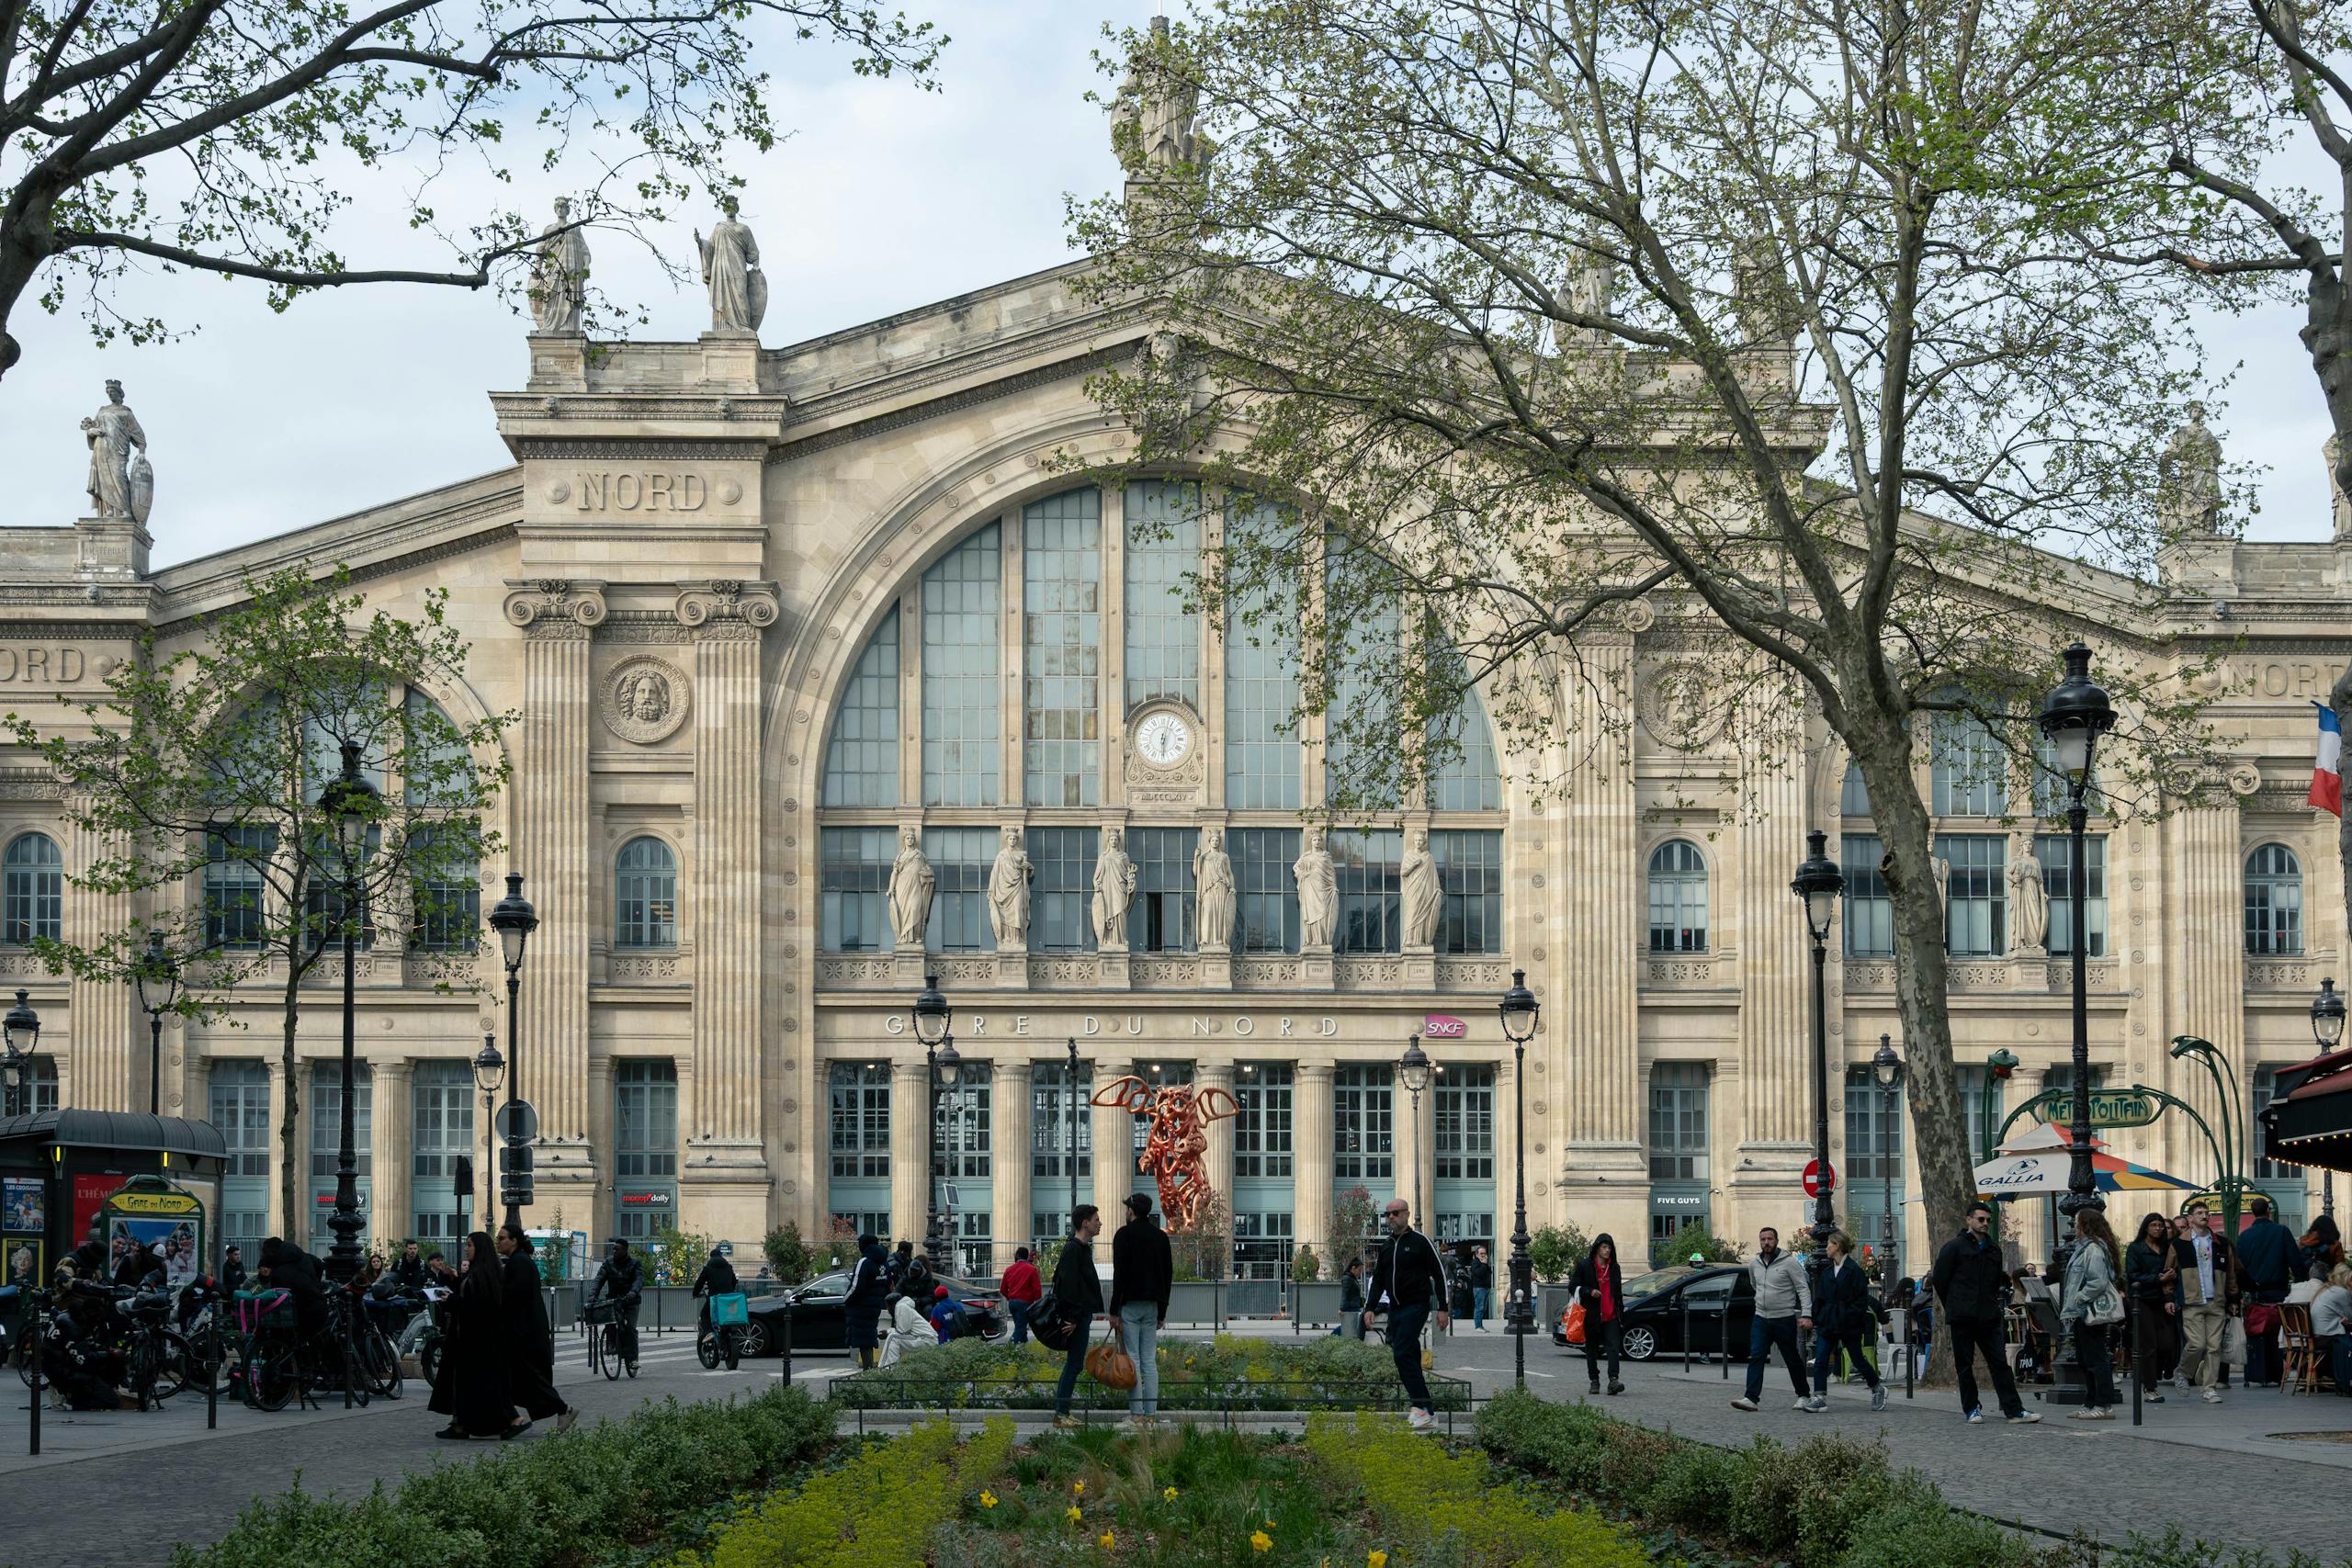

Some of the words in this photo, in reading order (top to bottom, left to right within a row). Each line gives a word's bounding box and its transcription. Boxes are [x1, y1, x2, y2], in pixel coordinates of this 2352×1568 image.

[576, 469, 707, 512] NORD
[886, 1016, 1029, 1036] GRE
[1084, 1016, 1143, 1037] DU
[1192, 1016, 1337, 1037] NORD
[1426, 1022, 1464, 1034] SNCF
[2047, 1096, 2148, 1122] METPOLITAIN
[1978, 1173, 2044, 1186] GALLIA
[128, 1196, 148, 1208] GARE
[159, 1197, 182, 1210] NORD
